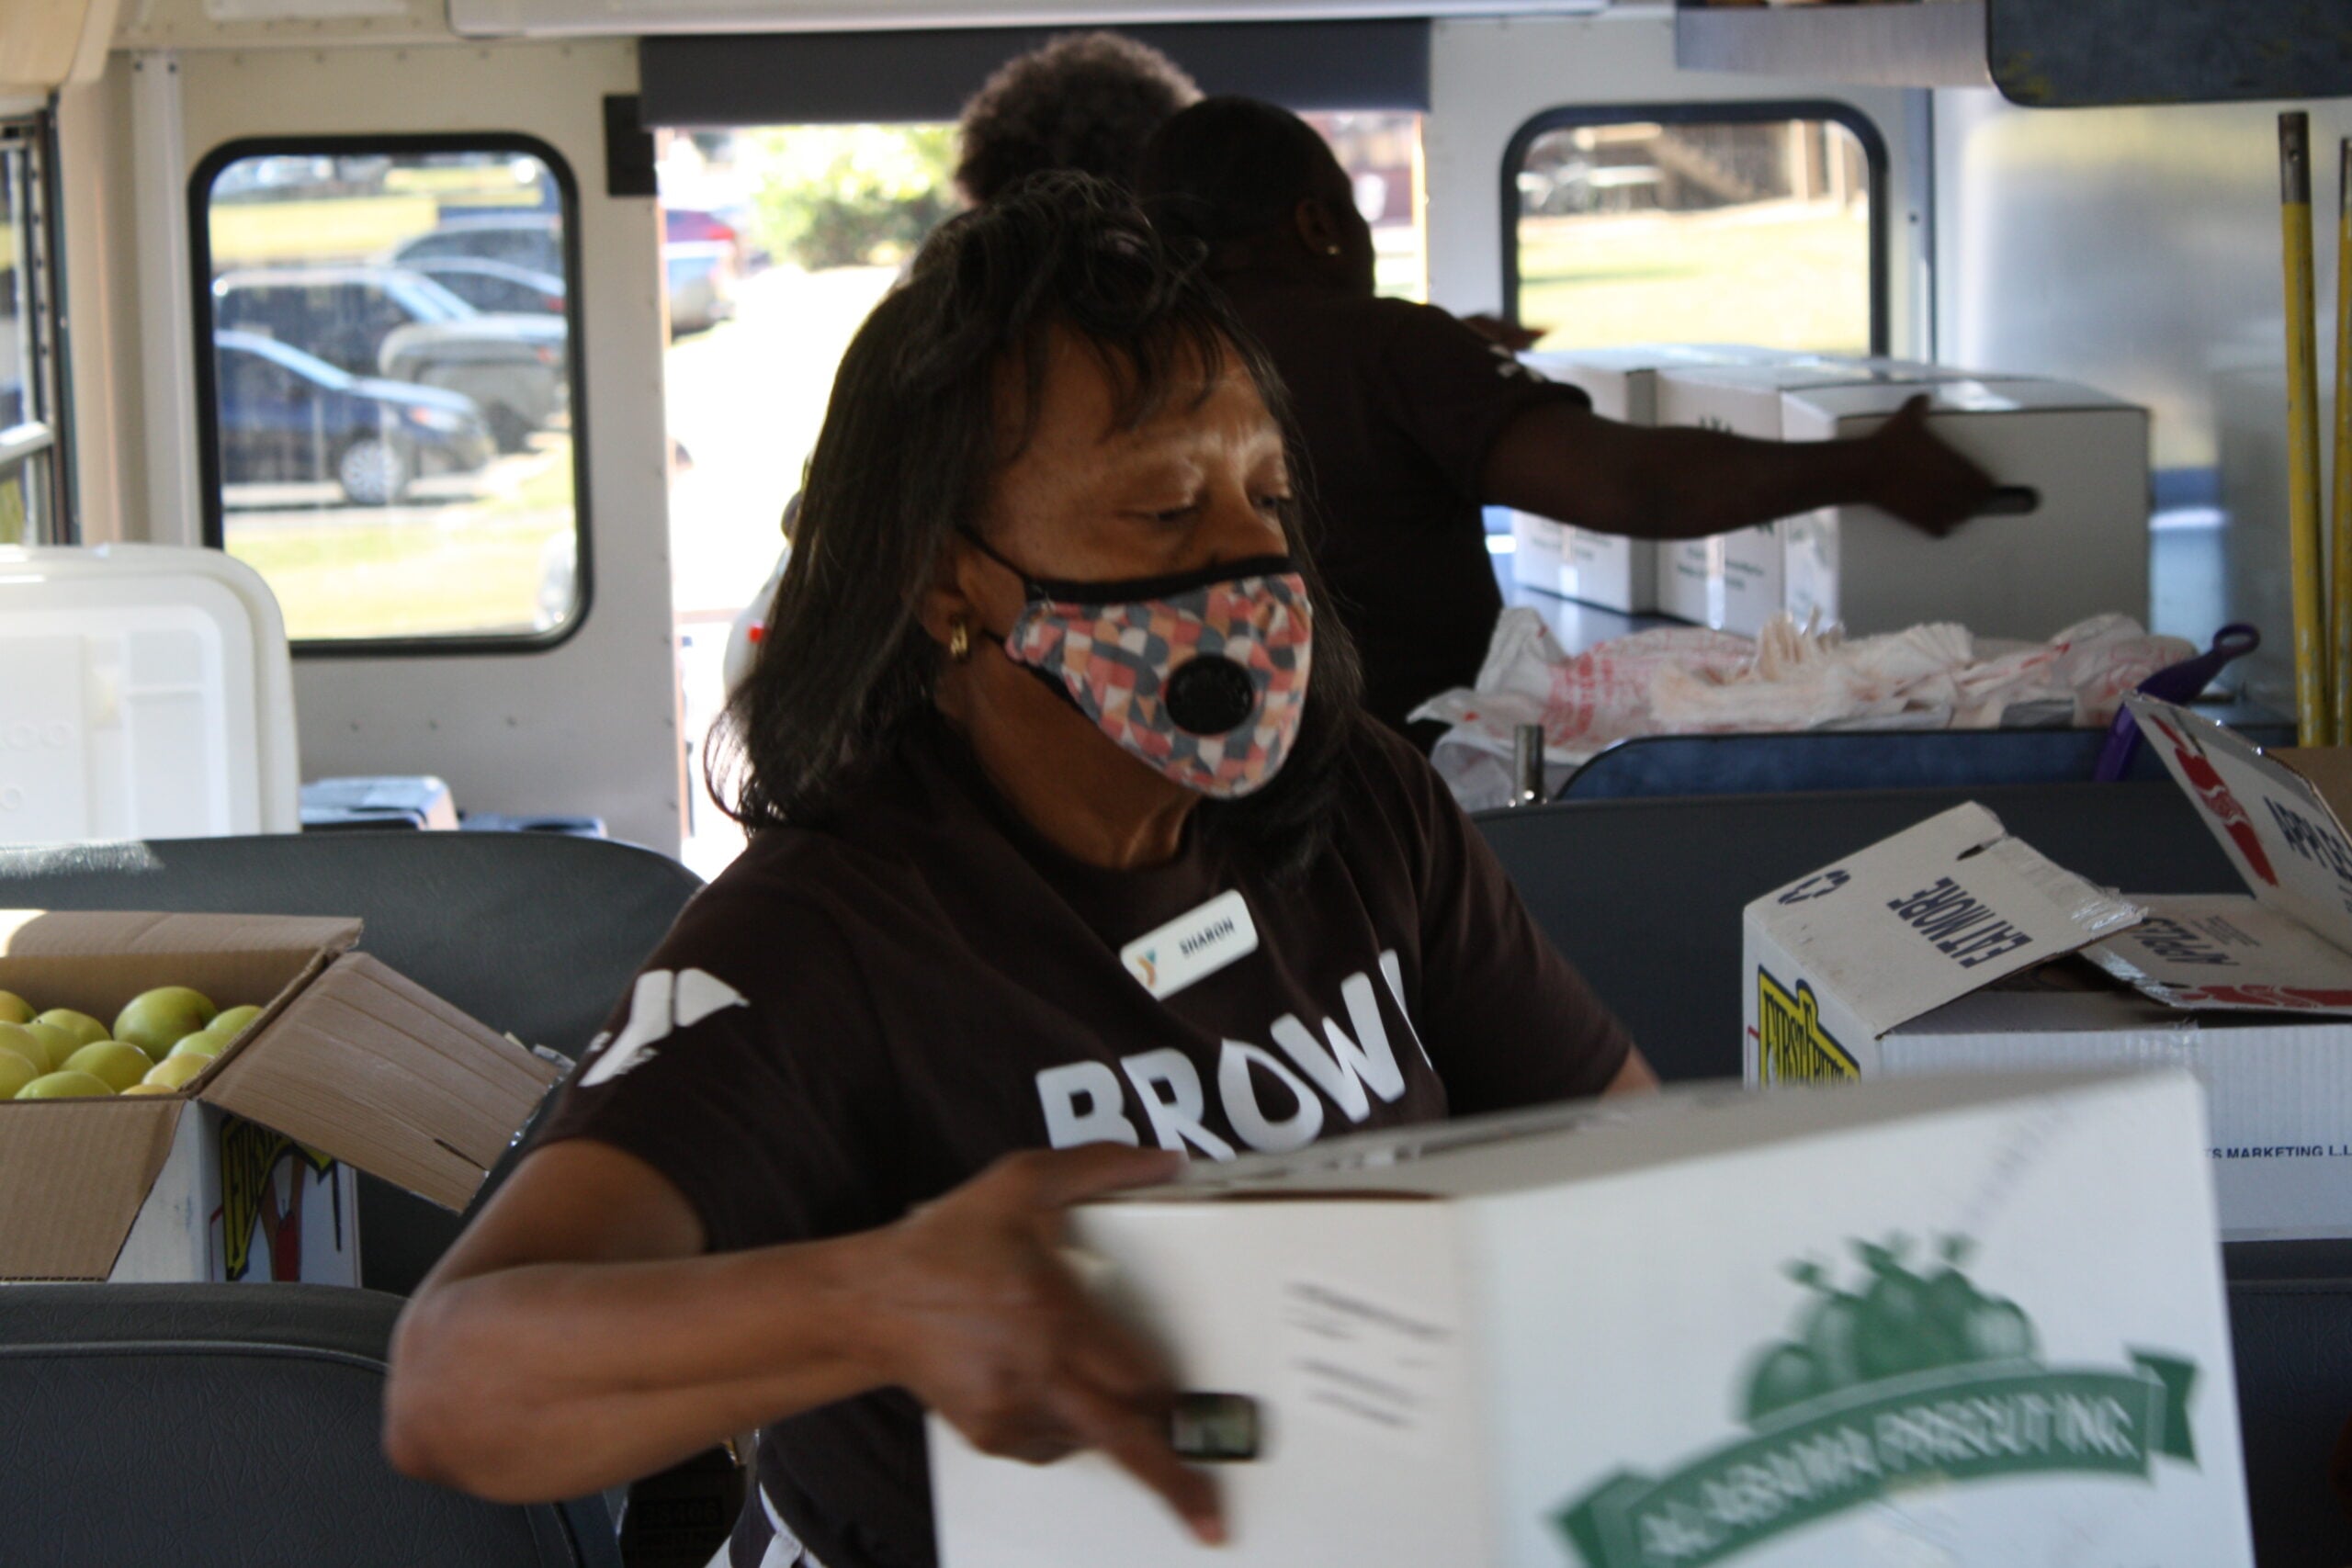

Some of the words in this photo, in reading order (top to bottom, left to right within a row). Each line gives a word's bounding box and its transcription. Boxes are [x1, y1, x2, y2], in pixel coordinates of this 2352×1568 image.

[1886, 876, 1996, 942] MORE
[1179, 917, 1236, 958] SHARON
[1936, 919, 2034, 969] EAT
[2227, 1145, 2324, 1158] MARKETING
